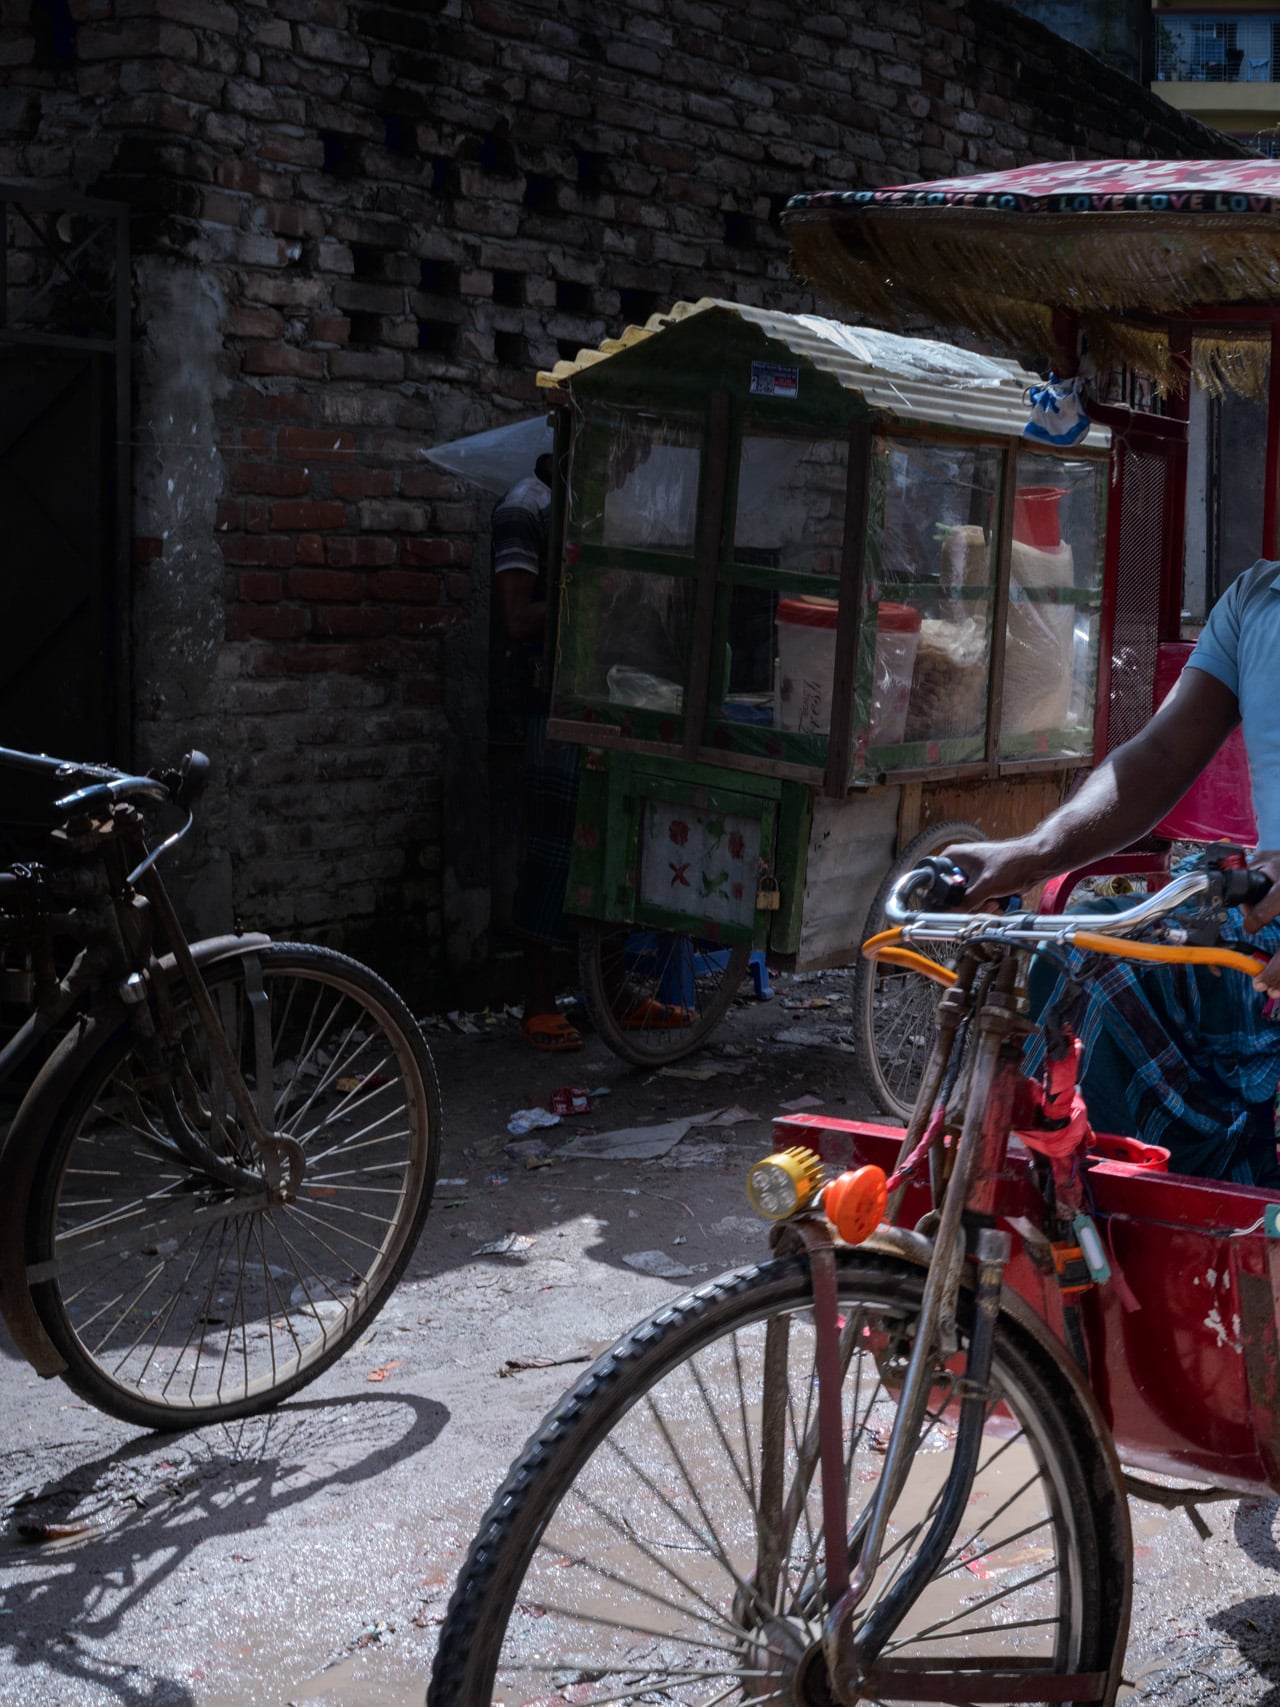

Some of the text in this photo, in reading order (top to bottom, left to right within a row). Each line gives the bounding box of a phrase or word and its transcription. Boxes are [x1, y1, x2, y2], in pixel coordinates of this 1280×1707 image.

[914, 191, 980, 207] LOVE
[1059, 195, 1127, 213] LOVE
[1135, 193, 1204, 211] LOVE
